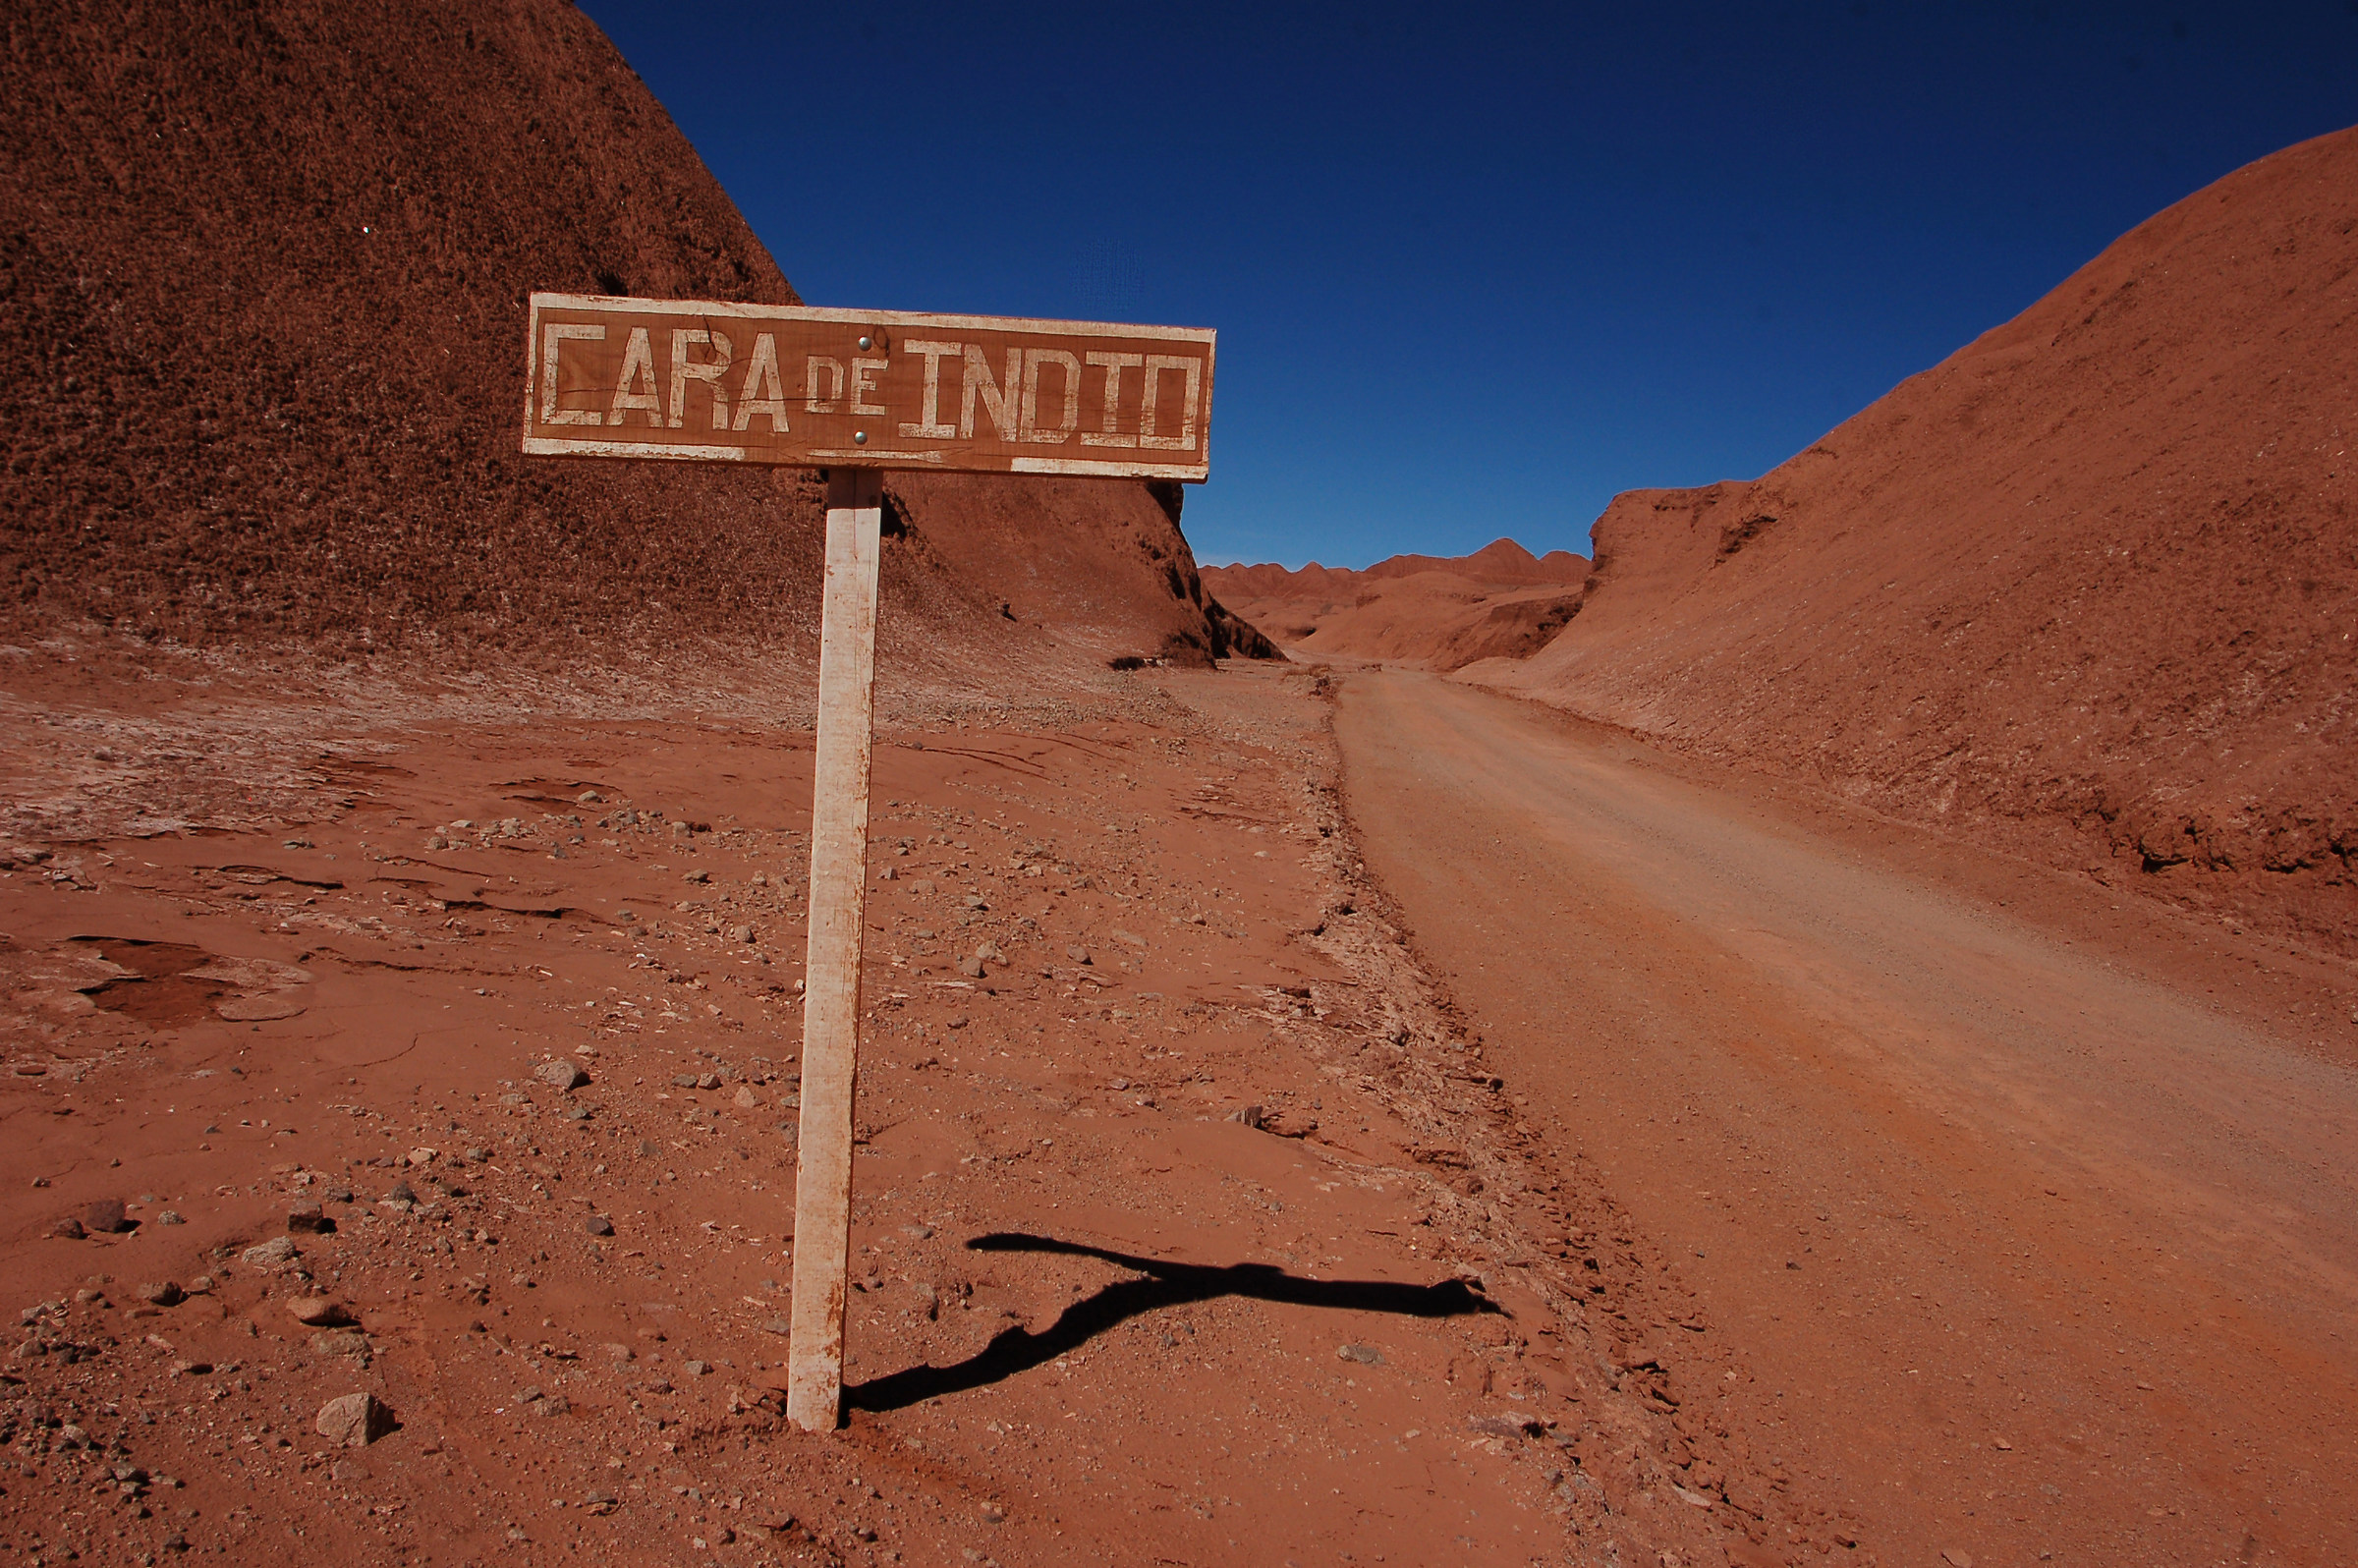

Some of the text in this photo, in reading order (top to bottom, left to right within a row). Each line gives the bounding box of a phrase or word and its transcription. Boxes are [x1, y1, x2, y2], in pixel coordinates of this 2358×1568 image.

[541, 323, 1202, 451] CARA DE INDIO
